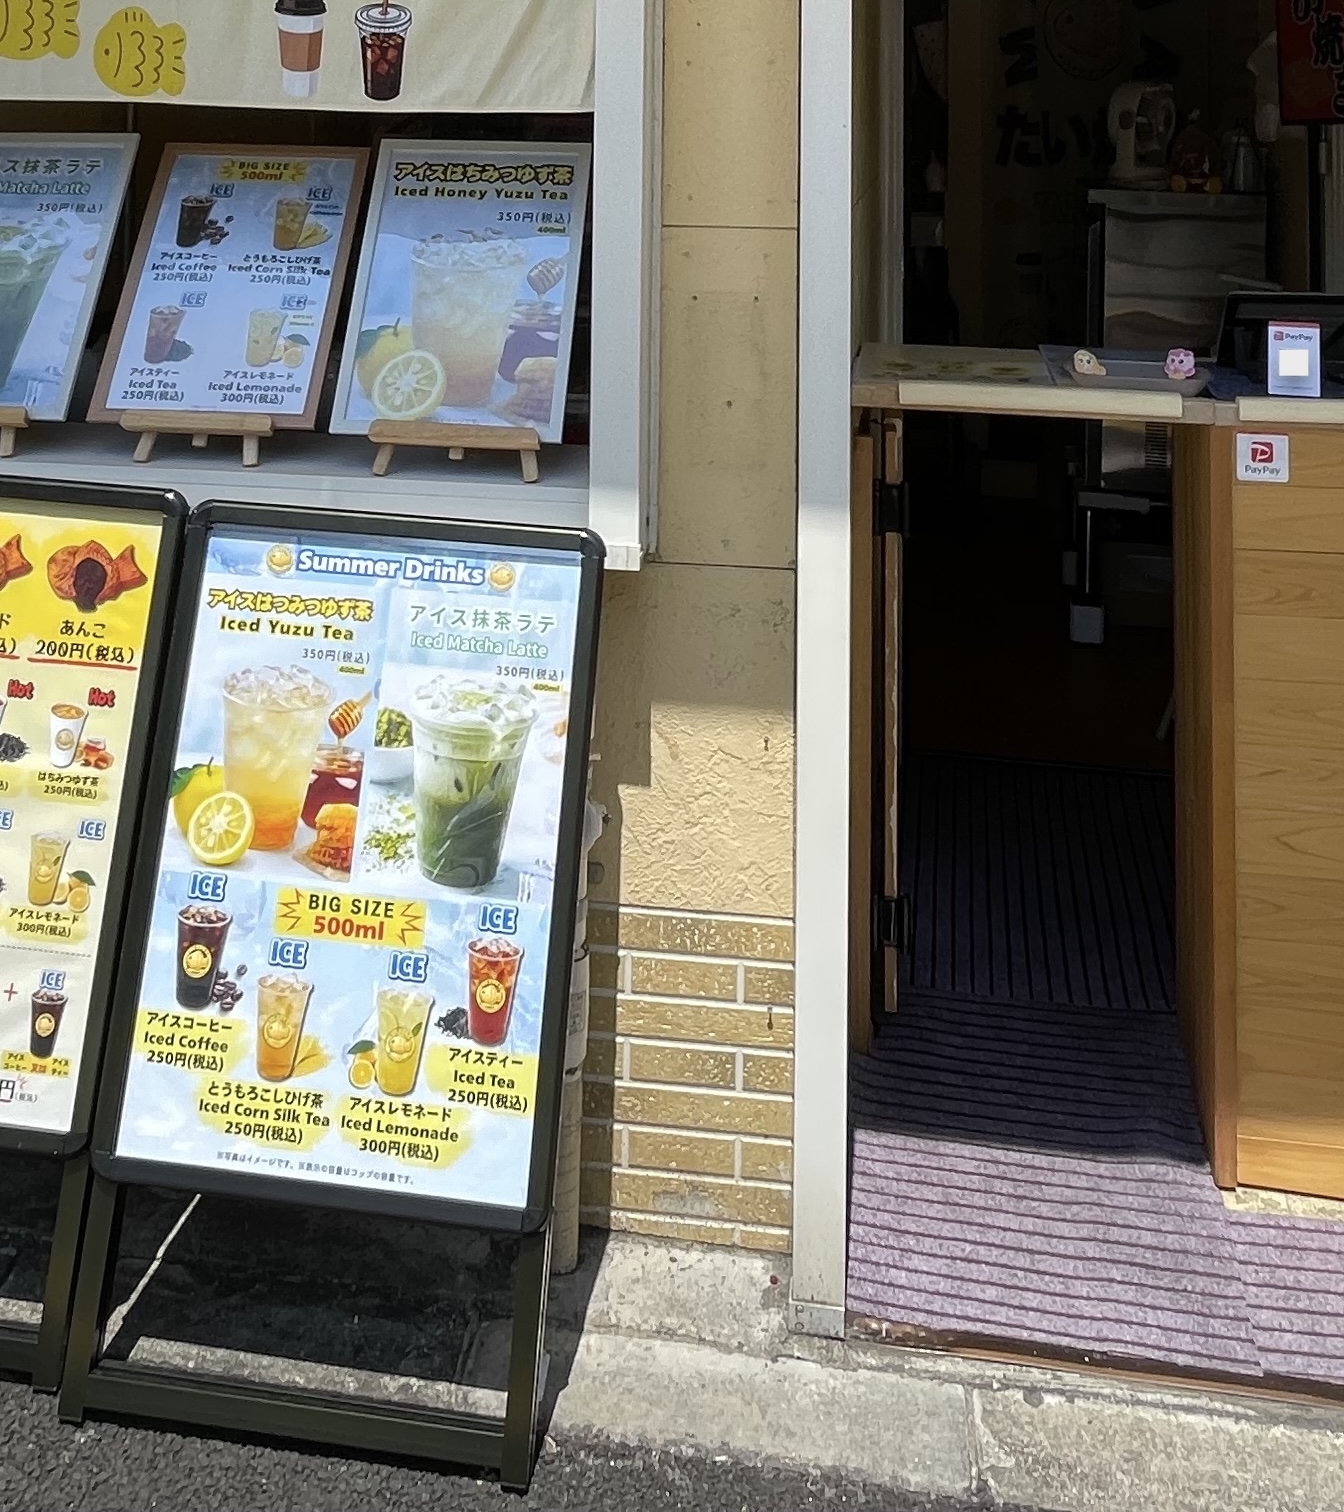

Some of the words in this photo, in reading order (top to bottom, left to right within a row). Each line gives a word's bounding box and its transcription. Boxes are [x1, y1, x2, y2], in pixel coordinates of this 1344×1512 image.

[238, 161, 260, 170] BIG
[263, 162, 290, 171] SIZE
[239, 170, 283, 181] 500ml
[394, 161, 575, 186] アイスはちみつゆず茶
[50, 180, 91, 195] Latte
[210, 184, 232, 196] ICE
[307, 187, 331, 200] ICE
[394, 185, 429, 197] Iced
[434, 186, 488, 200] Honey
[495, 187, 535, 200] Yuzu
[541, 189, 568, 200] Tea
[496, 211, 572, 225] 350円(税込)
[160, 252, 218, 262] アイスコーヒー
[151, 262, 176, 272] Iced
[177, 262, 217, 273] Coffee
[227, 263, 252, 273] Iced
[255, 264, 283, 274] Corn
[310, 266, 331, 277] Tea
[182, 293, 204, 306] ICE
[129, 368, 180, 377] アイスティー
[223, 370, 295, 381] アイスレモネード
[128, 379, 153, 389] Iced
[157, 380, 177, 389] Tea
[208, 381, 234, 392] Iced
[236, 382, 303, 394] Lemonade
[1244, 464, 1282, 477] PayPay
[298, 549, 401, 578] Summer
[404, 557, 485, 584] Drinks
[59, 619, 107, 639] あんこ
[221, 616, 261, 632] Iced
[269, 620, 315, 638] Yuzu
[322, 625, 354, 641] Tea
[409, 604, 556, 634] アイス抹茶ラテ
[411, 631, 444, 649] Iced
[447, 634, 504, 655] Matcha
[508, 639, 548, 658] Latte
[302, 648, 371, 665] 350円(税込)
[495, 665, 565, 682] 350円(税込)
[7, 678, 35, 699] Hot
[88, 687, 116, 708] Hot
[37, 771, 99, 787] はちみつゆず茶
[79, 820, 104, 837] ICE
[191, 875, 224, 898] ICE
[9, 907, 80, 924] アイスレモネード
[308, 894, 342, 911] BIG
[350, 899, 395, 918] SIZE
[313, 915, 385, 941] 500ml
[480, 905, 516, 931] ICE
[271, 941, 306, 965] ICE
[391, 953, 426, 978] ICE
[41, 971, 64, 988] ICE
[146, 1011, 233, 1033] アイスコーヒー
[144, 1031, 175, 1046] Iced
[179, 1034, 229, 1053] Coffee
[146, 1050, 225, 1072] 250円(税込)
[448, 1047, 524, 1068] アイスティー
[453, 1069, 485, 1085] Iced
[489, 1074, 515, 1089] Tea
[207, 1081, 324, 1109] とうもろこしひげ茶
[447, 1088, 528, 1113] 250円(税込)
[199, 1099, 230, 1114] Iced
[234, 1102, 270, 1120] Corn
[273, 1107, 301, 1124] Silk
[305, 1111, 331, 1127] Tea
[349, 1096, 452, 1122] アイスレモネード
[224, 1120, 303, 1145] 250円(税込)
[340, 1115, 372, 1132] Iced
[376, 1119, 459, 1143] Lemonade
[359, 1138, 439, 1163] 300円(税込)
